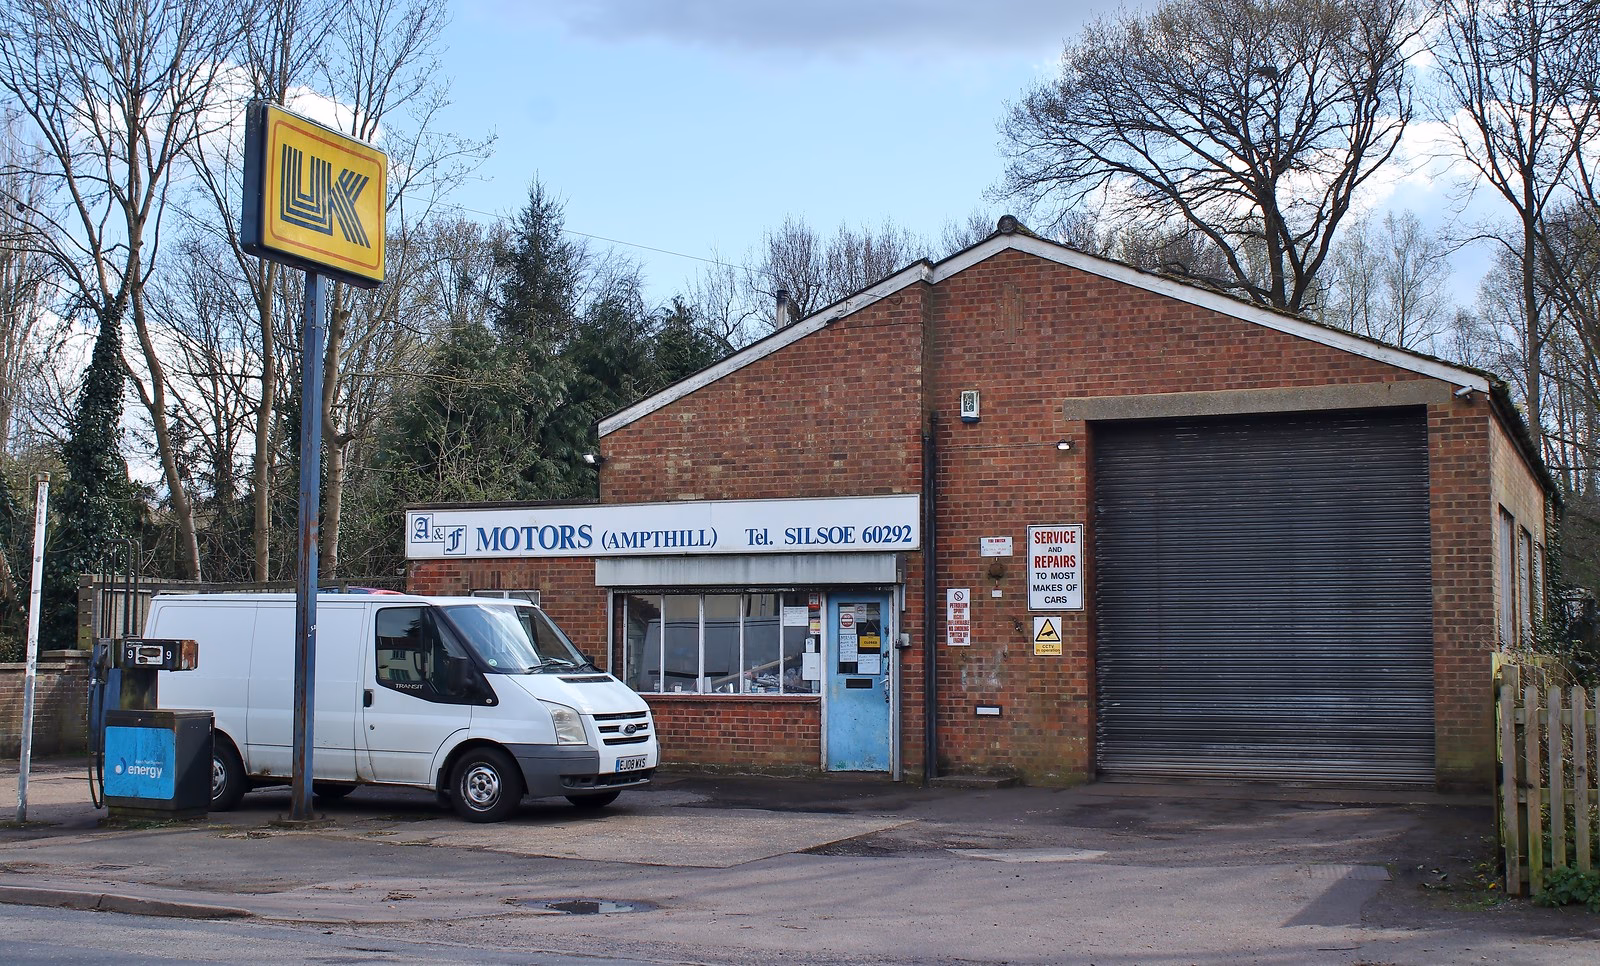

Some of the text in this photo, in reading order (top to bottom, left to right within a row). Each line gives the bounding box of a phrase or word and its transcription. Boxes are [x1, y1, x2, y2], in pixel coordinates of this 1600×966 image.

[280, 143, 371, 249] UK
[413, 516, 431, 540] A
[434, 528, 444, 541] &
[475, 524, 593, 552] MOTORS
[601, 527, 718, 551] (AMPTHILL)
[745, 528, 774, 546] Tel.
[784, 526, 856, 545] SILSOE
[862, 524, 912, 543] 60292
[1034, 531, 1076, 544] SERVICE
[1034, 555, 1076, 569] REPAIRS
[1036, 572, 1075, 580] TO MOST
[1033, 584, 1078, 592] MAKES OF
[1044, 596, 1067, 604] CARS
[128, 650, 133, 659] 9
[166, 651, 171, 660] 9
[128, 765, 163, 778] energy
